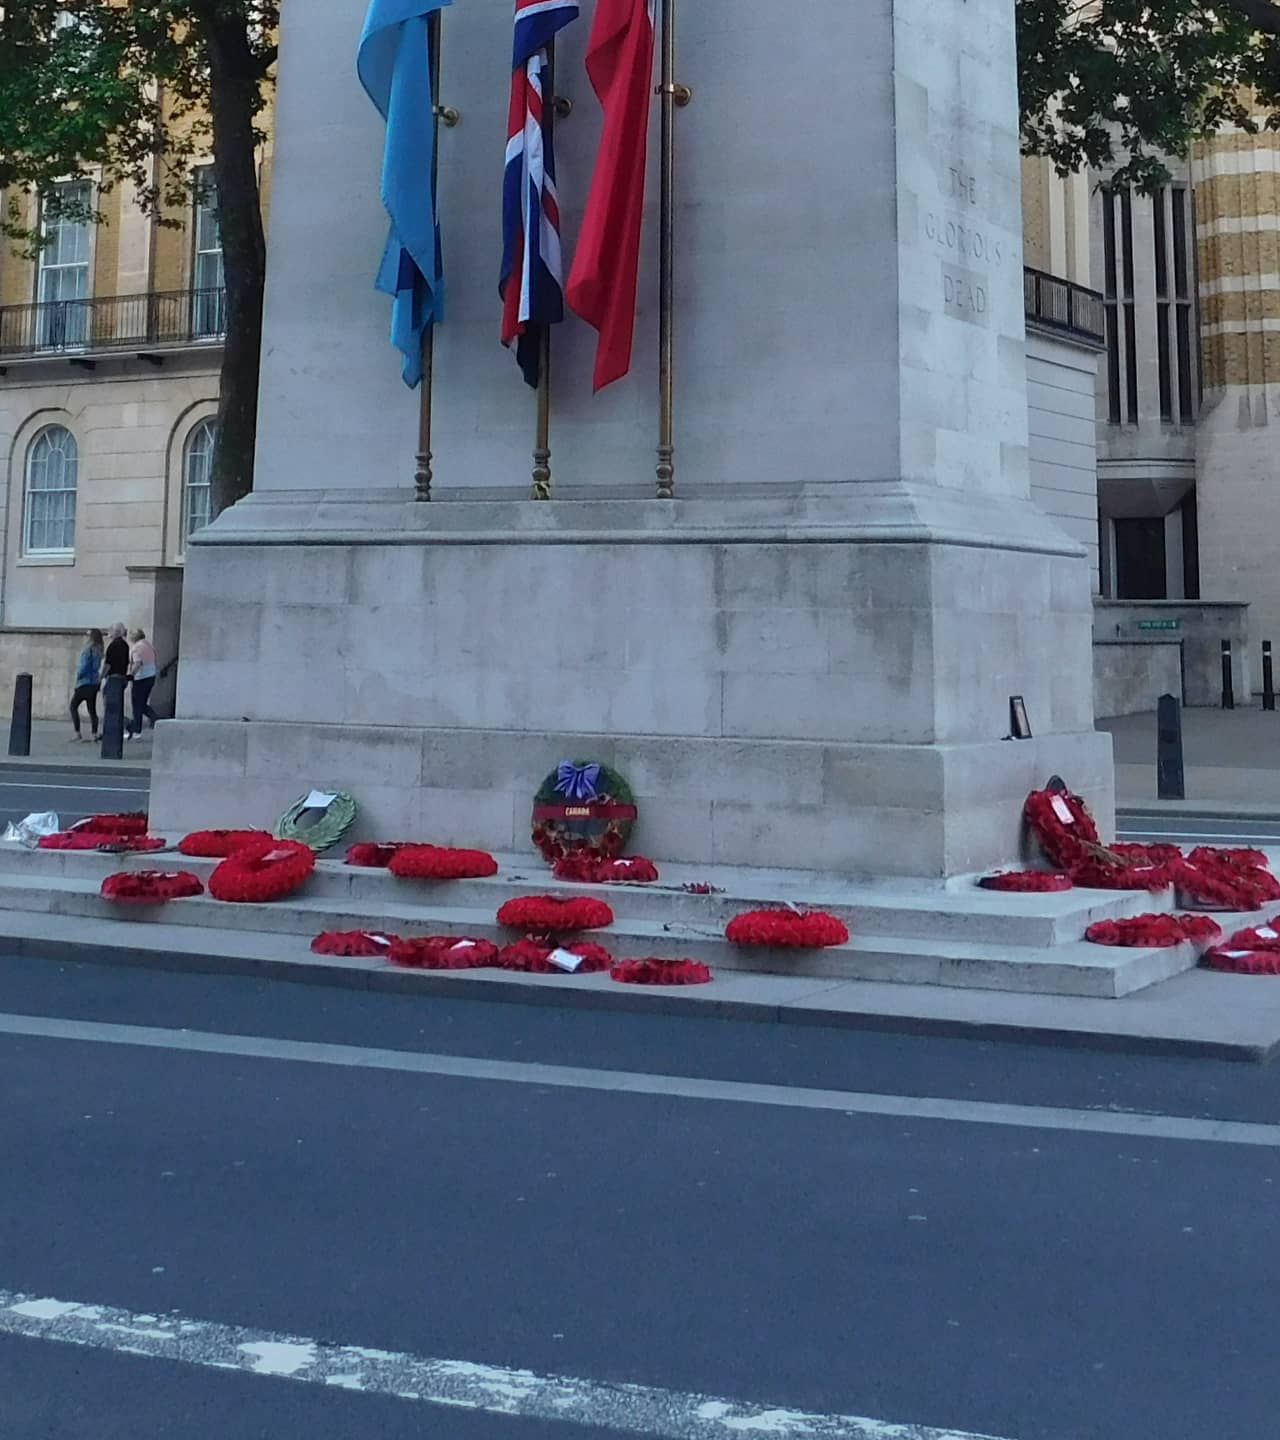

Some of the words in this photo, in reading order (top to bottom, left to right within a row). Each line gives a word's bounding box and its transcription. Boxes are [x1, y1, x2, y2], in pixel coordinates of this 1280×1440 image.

[949, 166, 977, 205] THE
[925, 213, 1001, 266] GLORIOUS
[943, 274, 986, 313] DEAD
[565, 806, 591, 817] CANADA
